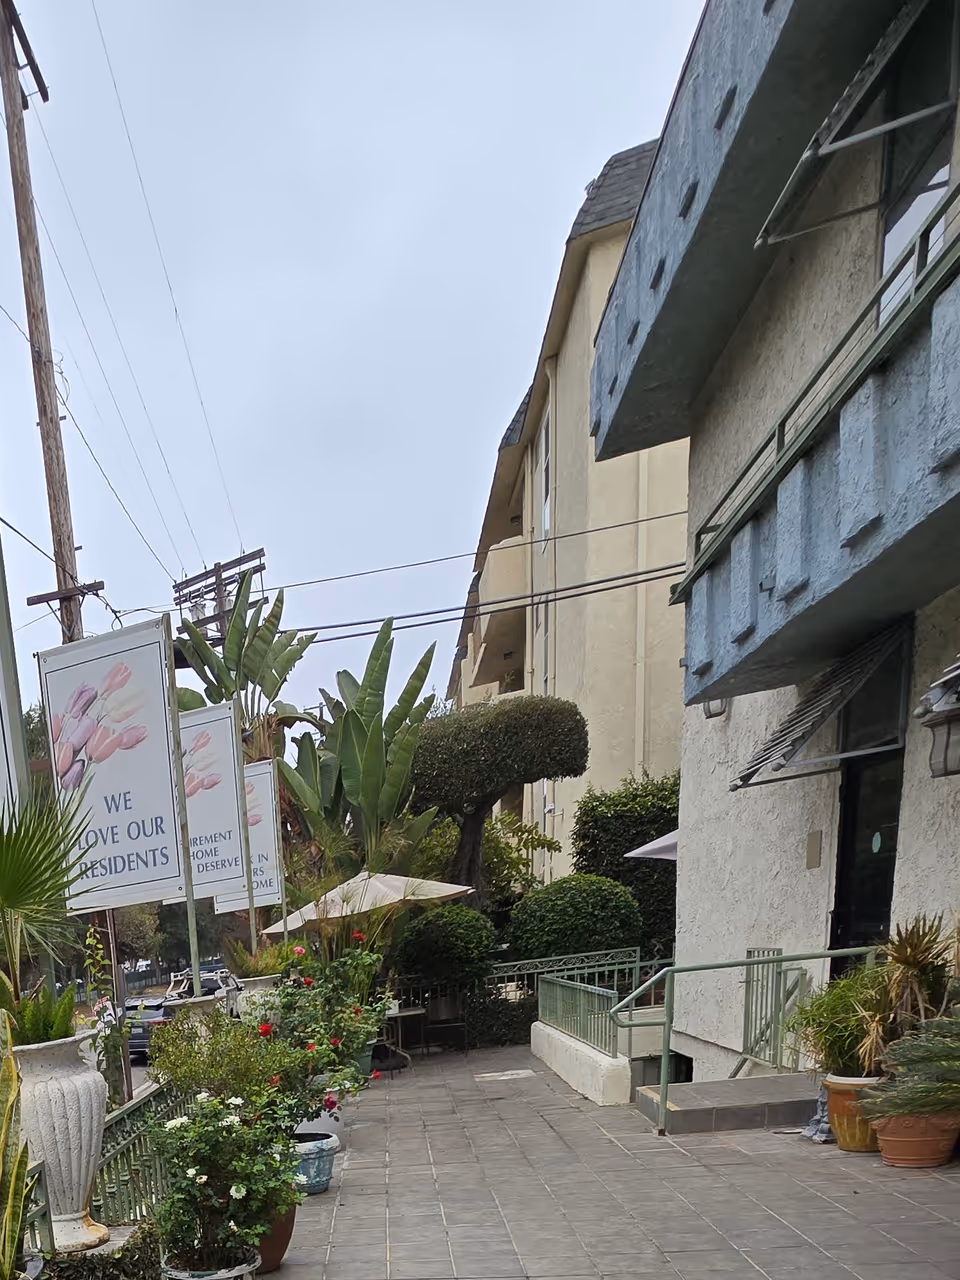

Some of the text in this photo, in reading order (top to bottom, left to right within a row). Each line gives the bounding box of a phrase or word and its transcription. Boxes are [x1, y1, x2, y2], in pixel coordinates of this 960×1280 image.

[103, 791, 133, 814] WE
[76, 815, 166, 850] LOVE OUR
[79, 846, 170, 880] RESIDENTS
[197, 857, 240, 873] DESERVE
